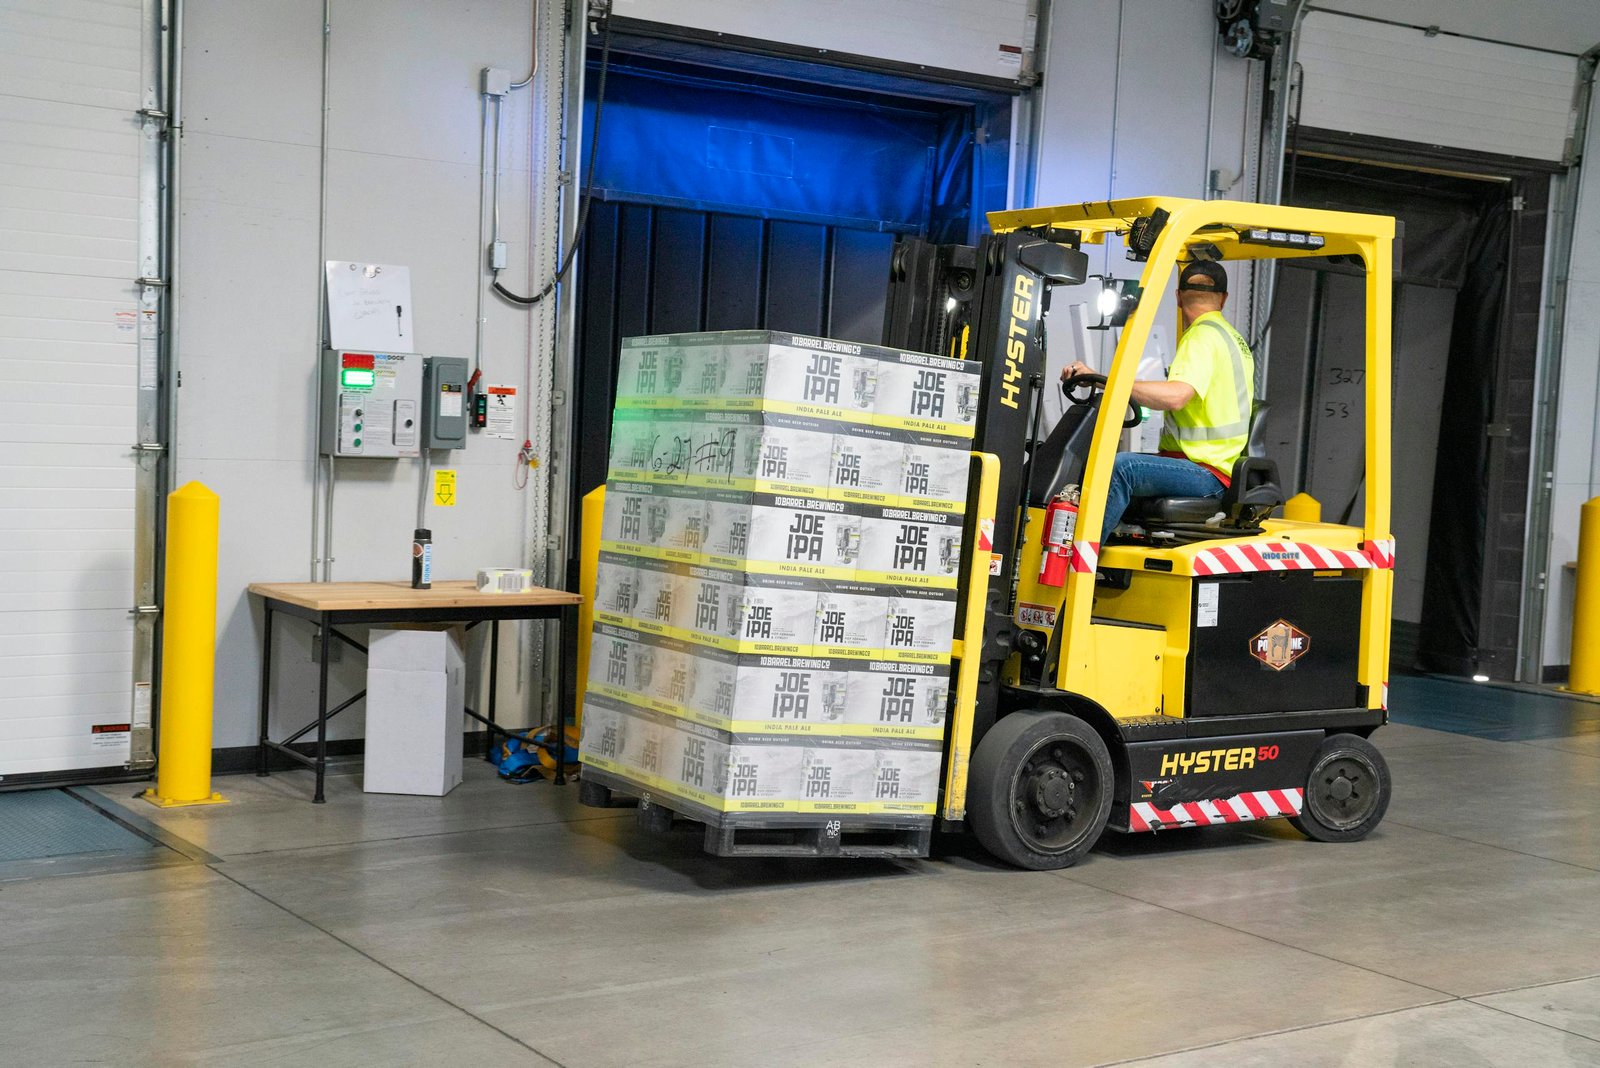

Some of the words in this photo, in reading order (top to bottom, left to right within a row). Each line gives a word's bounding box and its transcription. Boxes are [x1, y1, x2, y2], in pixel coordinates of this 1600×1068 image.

[1001, 274, 1033, 409] HYSTER
[639, 351, 658, 369] JOE
[807, 354, 842, 377] JOE
[702, 363, 718, 377] JOE
[748, 363, 764, 376] JOE
[1330, 368, 1365, 384] 327
[636, 371, 656, 393] IPA
[701, 377, 716, 394] IPA
[746, 377, 762, 394] IPA
[804, 375, 840, 404] IPA
[913, 370, 946, 392] JOE
[910, 391, 944, 418] IPA
[631, 452, 645, 467] IPA
[764, 445, 788, 460] JOE
[838, 454, 861, 468] JOE
[762, 459, 787, 479] IPA
[836, 468, 859, 486] IPA
[907, 462, 929, 477] JOE
[905, 476, 927, 494] IPA
[623, 497, 642, 516] JOE
[620, 517, 640, 540] IPA
[686, 517, 701, 530] JOE
[730, 523, 747, 537] JOE
[790, 513, 825, 535] JOE
[684, 532, 700, 548] IPA
[896, 525, 929, 546] JOE
[728, 537, 746, 555] IPA
[786, 535, 823, 561] IPA
[893, 545, 926, 571] IPA
[1262, 552, 1280, 560] RIDE
[1282, 552, 1299, 560] RITE
[617, 583, 631, 597] JOE
[657, 590, 671, 604] JOE
[698, 583, 720, 605] JOE
[616, 597, 629, 613] IPA
[655, 604, 670, 621] IPA
[748, 606, 772, 620] JOE
[695, 603, 718, 631] IPA
[822, 611, 846, 625] JOE
[893, 616, 915, 630] JOE
[746, 620, 771, 638] IPA
[820, 626, 844, 643] IPA
[890, 630, 913, 647] IPA
[609, 641, 628, 661] JOE
[607, 660, 626, 686] IPA
[672, 670, 686, 684] JOE
[717, 681, 732, 697] JOE
[775, 672, 811, 692] JOE
[883, 677, 916, 698] JOE
[670, 684, 684, 702] IPA
[714, 697, 731, 715] IPA
[772, 693, 809, 719] IPA
[880, 698, 914, 722] IPA
[603, 727, 616, 741] JOE
[601, 742, 615, 758] IPA
[644, 740, 658, 754] JOE
[684, 737, 706, 760] JOE
[642, 754, 656, 772] IPA
[1160, 747, 1256, 777] HYSTER
[1258, 745, 1279, 761] 50
[682, 757, 704, 786] IPA
[734, 764, 758, 778] JOE
[808, 767, 832, 780] JOE
[878, 768, 900, 781] JOE
[732, 779, 756, 796] IPA
[806, 781, 830, 798] IPA
[876, 781, 898, 798] IPA
